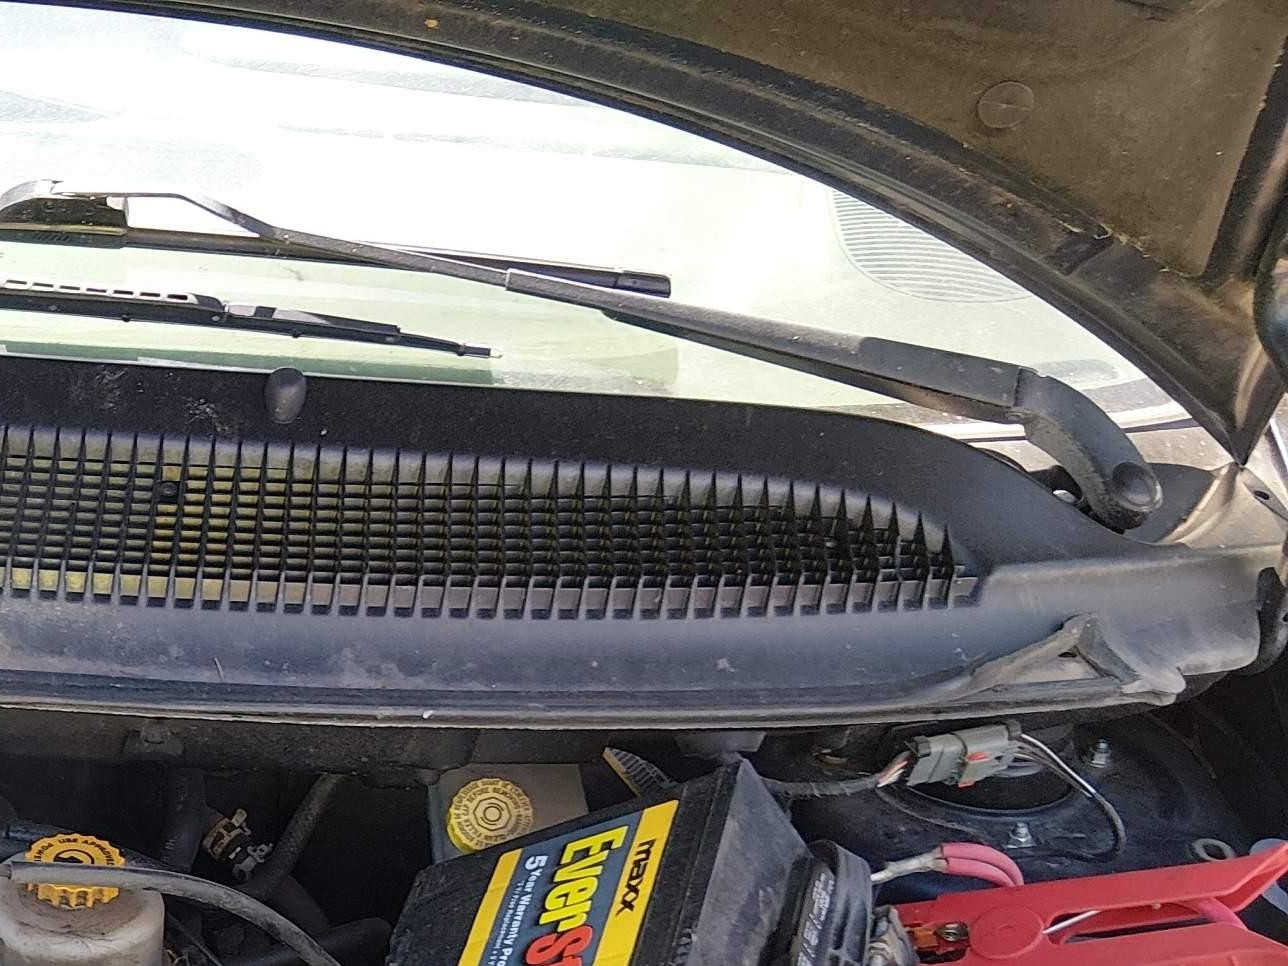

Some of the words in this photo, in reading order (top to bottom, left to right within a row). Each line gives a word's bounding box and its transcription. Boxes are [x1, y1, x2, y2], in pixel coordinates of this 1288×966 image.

[520, 869, 542, 892] Year
[524, 855, 548, 870] 5
[615, 838, 656, 916] maxx
[500, 894, 531, 945] Warranty
